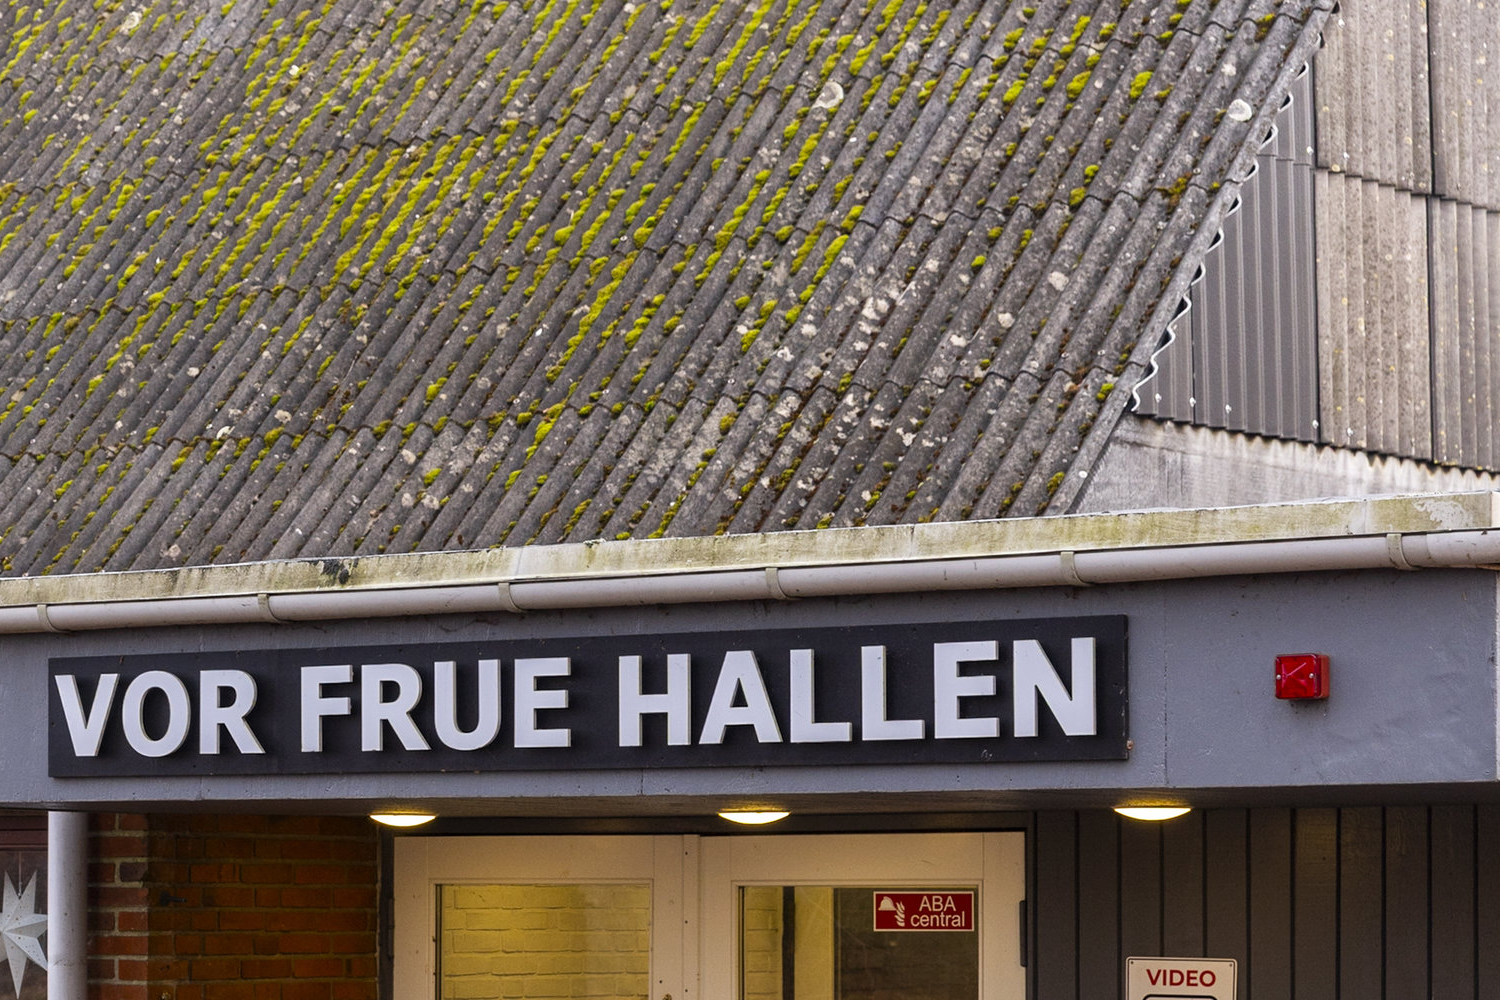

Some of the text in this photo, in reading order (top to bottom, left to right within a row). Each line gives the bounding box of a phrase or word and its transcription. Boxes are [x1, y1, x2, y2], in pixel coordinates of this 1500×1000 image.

[54, 636, 1098, 758] VOR FRUE HALLEN
[918, 895, 957, 912] ABA
[910, 910, 965, 927] central
[1145, 968, 1217, 988] VIDEO
